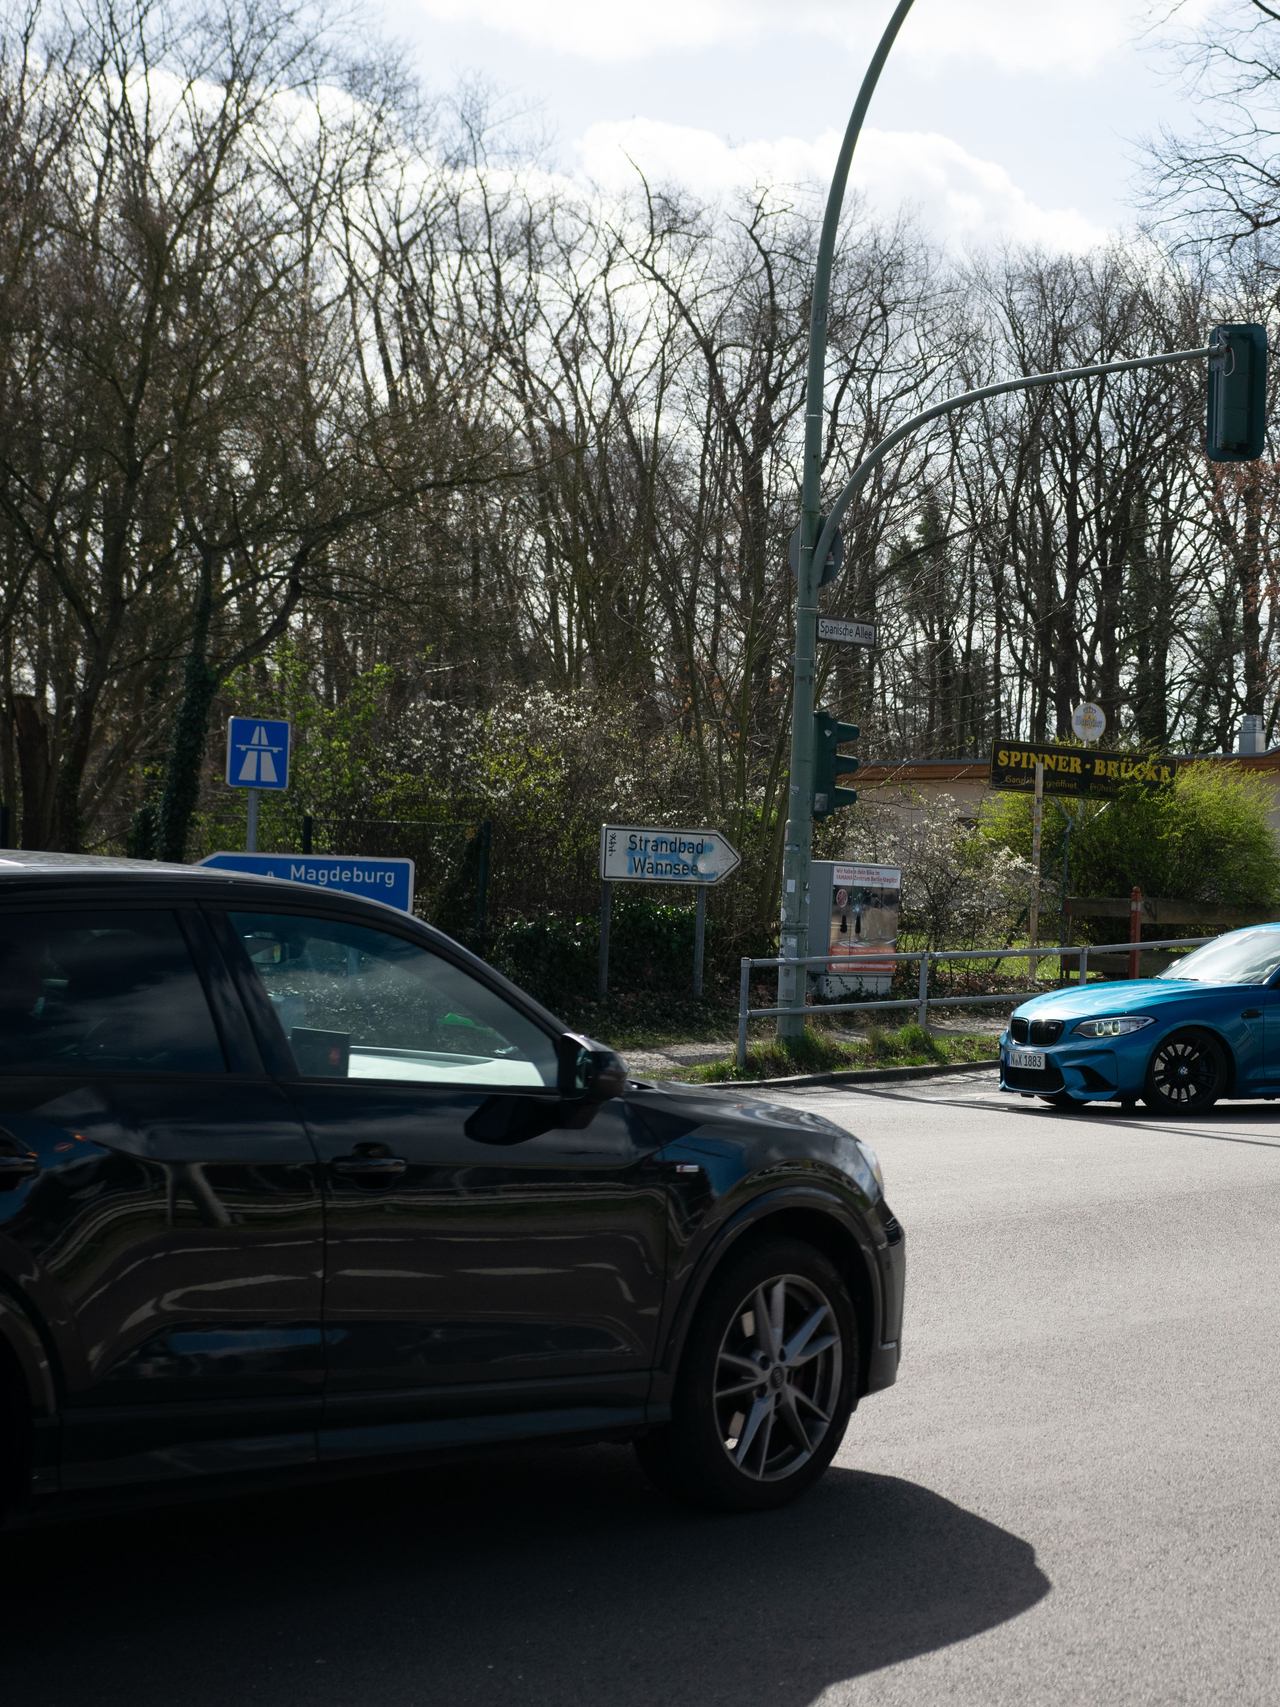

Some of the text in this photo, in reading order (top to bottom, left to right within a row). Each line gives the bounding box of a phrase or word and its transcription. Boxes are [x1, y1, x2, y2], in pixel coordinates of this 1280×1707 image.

[820, 621, 872, 640] Spanische Allee
[998, 750, 1082, 774] SPINNER
[1094, 757, 1171, 783] BRÜCKE
[1046, 779, 1078, 789] geöffnet
[628, 834, 704, 854] Strandbad
[290, 864, 395, 888] Magdeburg
[633, 857, 698, 876] Wannsee
[1010, 1054, 1016, 1065] N
[1024, 1055, 1041, 1067] 1883
